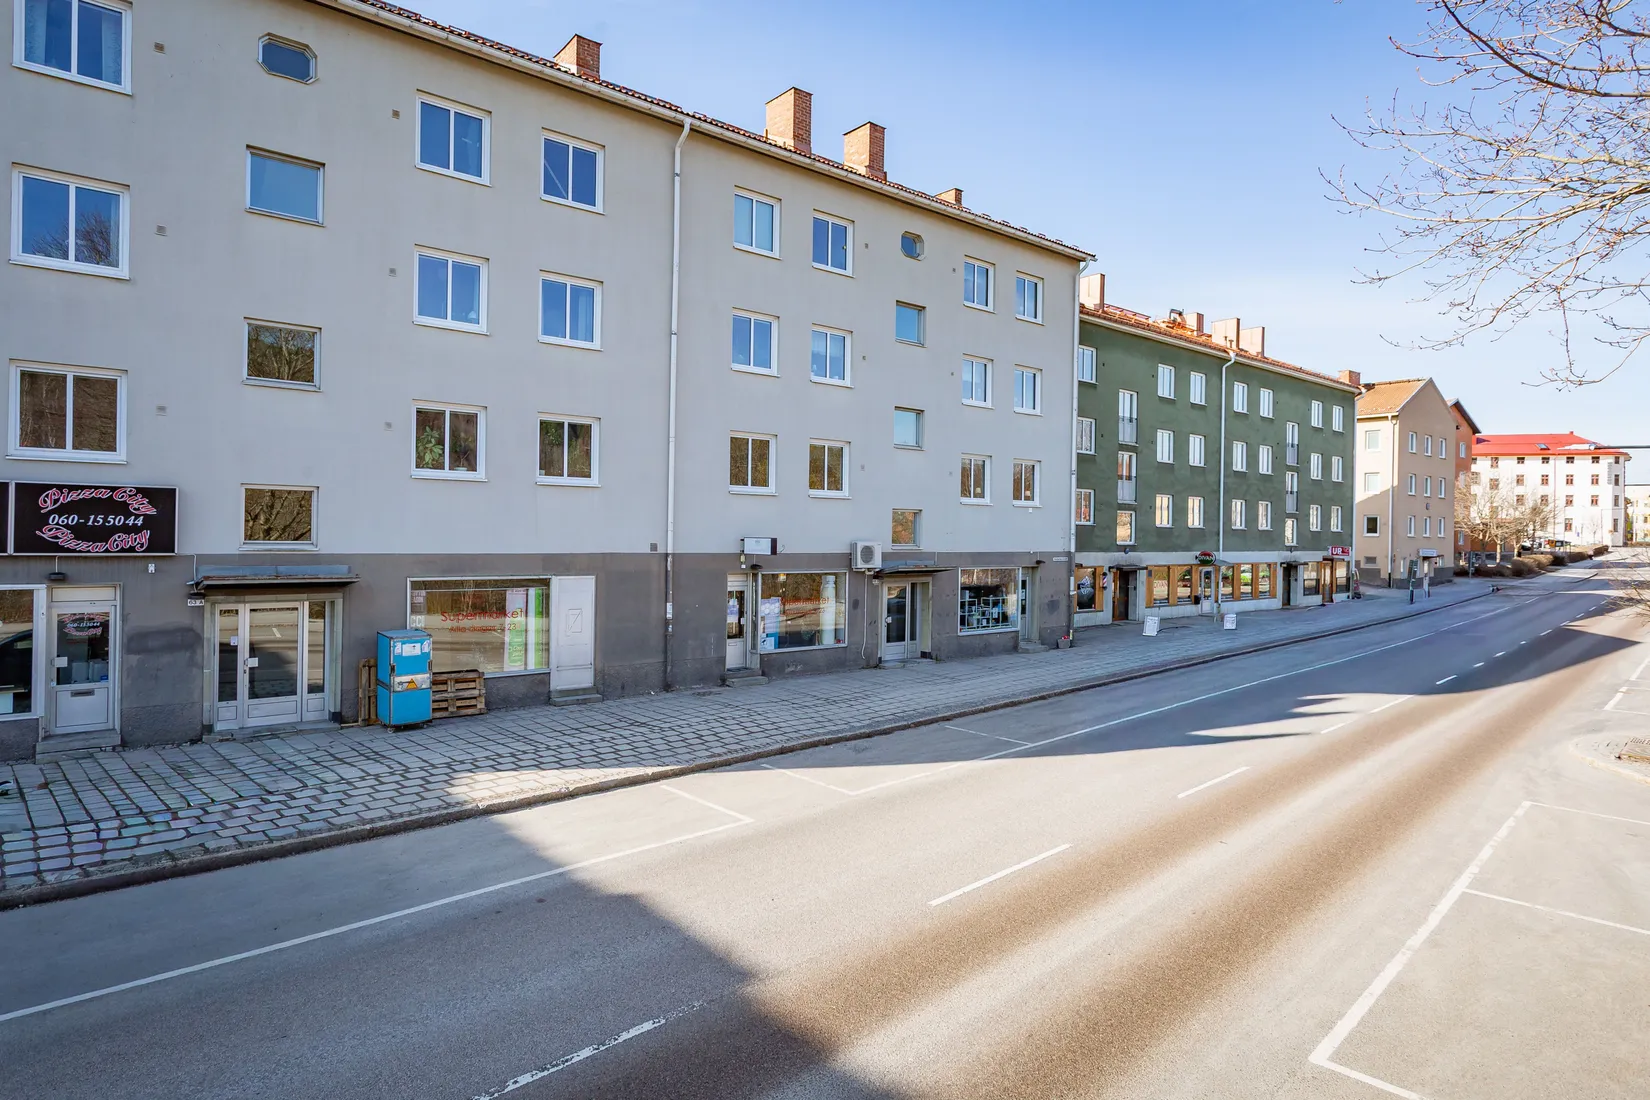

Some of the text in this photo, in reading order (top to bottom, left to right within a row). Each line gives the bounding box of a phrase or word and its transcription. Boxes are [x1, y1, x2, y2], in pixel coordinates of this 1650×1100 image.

[38, 487, 157, 515] Pizza City
[36, 524, 150, 553] Pizza City
[441, 608, 524, 623] Supermarket
